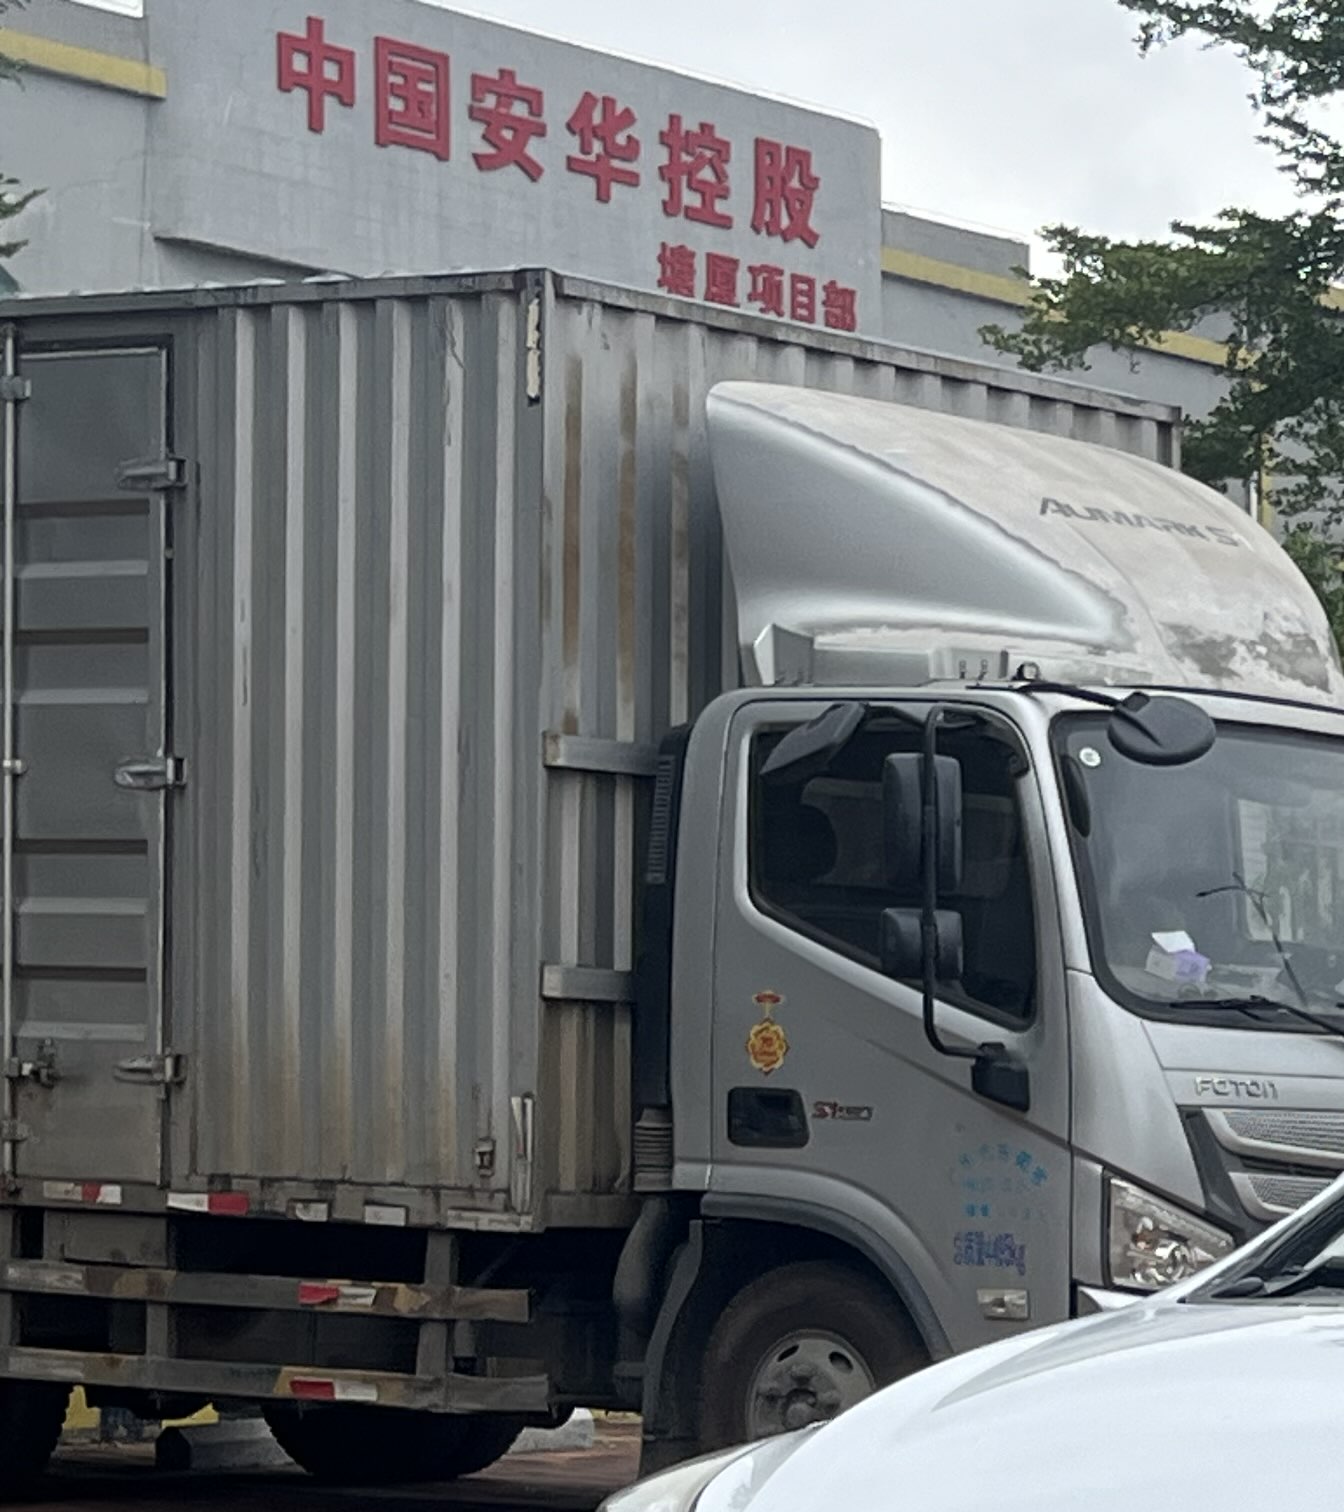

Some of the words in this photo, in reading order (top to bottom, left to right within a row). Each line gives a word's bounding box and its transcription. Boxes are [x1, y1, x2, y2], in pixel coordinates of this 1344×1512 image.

[276, 15, 821, 249] 中国安华控股
[1040, 497, 1210, 541] AUMARK
